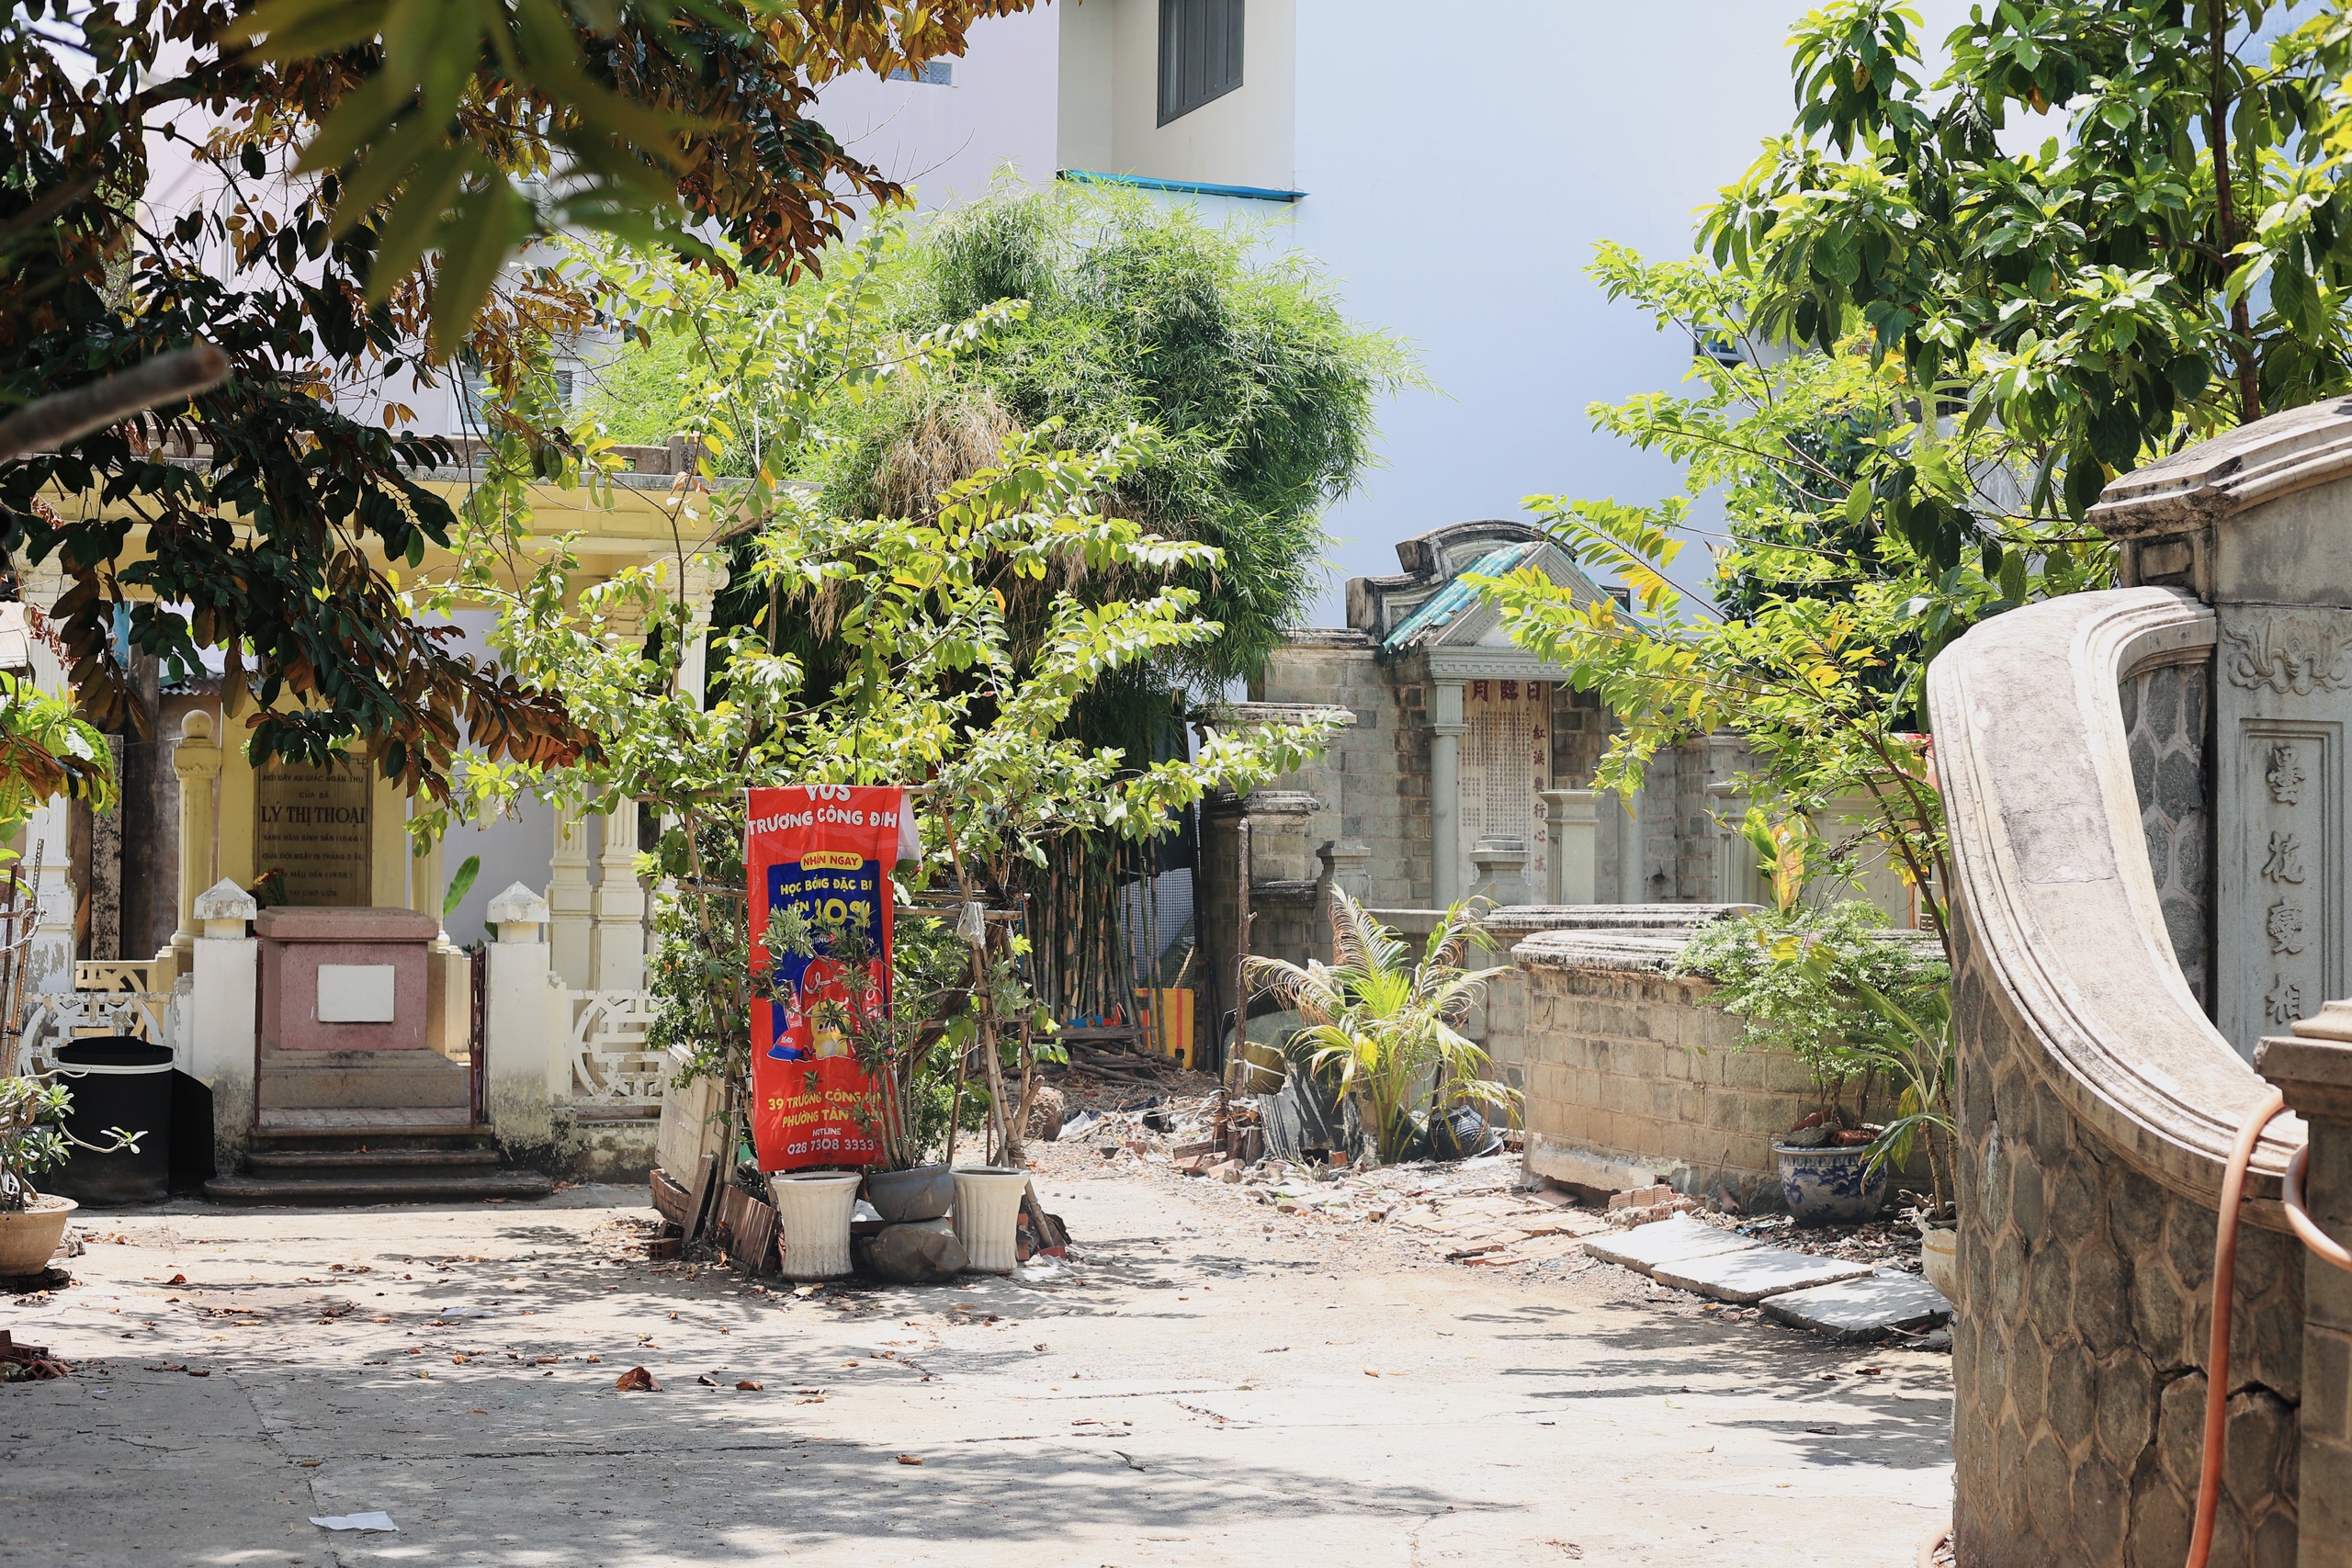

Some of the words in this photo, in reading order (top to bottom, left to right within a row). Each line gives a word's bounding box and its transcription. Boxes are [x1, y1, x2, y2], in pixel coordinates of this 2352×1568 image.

[805, 784, 851, 802] VUS
[261, 801, 282, 823] LÝ
[286, 807, 311, 826] THỊ
[314, 807, 365, 828] THOẠI
[749, 810, 813, 835] TRƯƠNG
[817, 805, 863, 825] CÔNG
[830, 855, 859, 866] NGAY
[780, 882, 802, 897] HỌC
[832, 876, 856, 892] ĐẶC
[768, 1098, 784, 1111] 39
[825, 1088, 861, 1102] CÔNG
[782, 1110, 819, 1128] PHƯỜNG
[821, 1106, 849, 1121] TÂN
[812, 1128, 842, 1137] HOTLINE
[787, 1142, 807, 1155] 028
[810, 1139, 840, 1151] 7308
[844, 1139, 874, 1151] 3333
